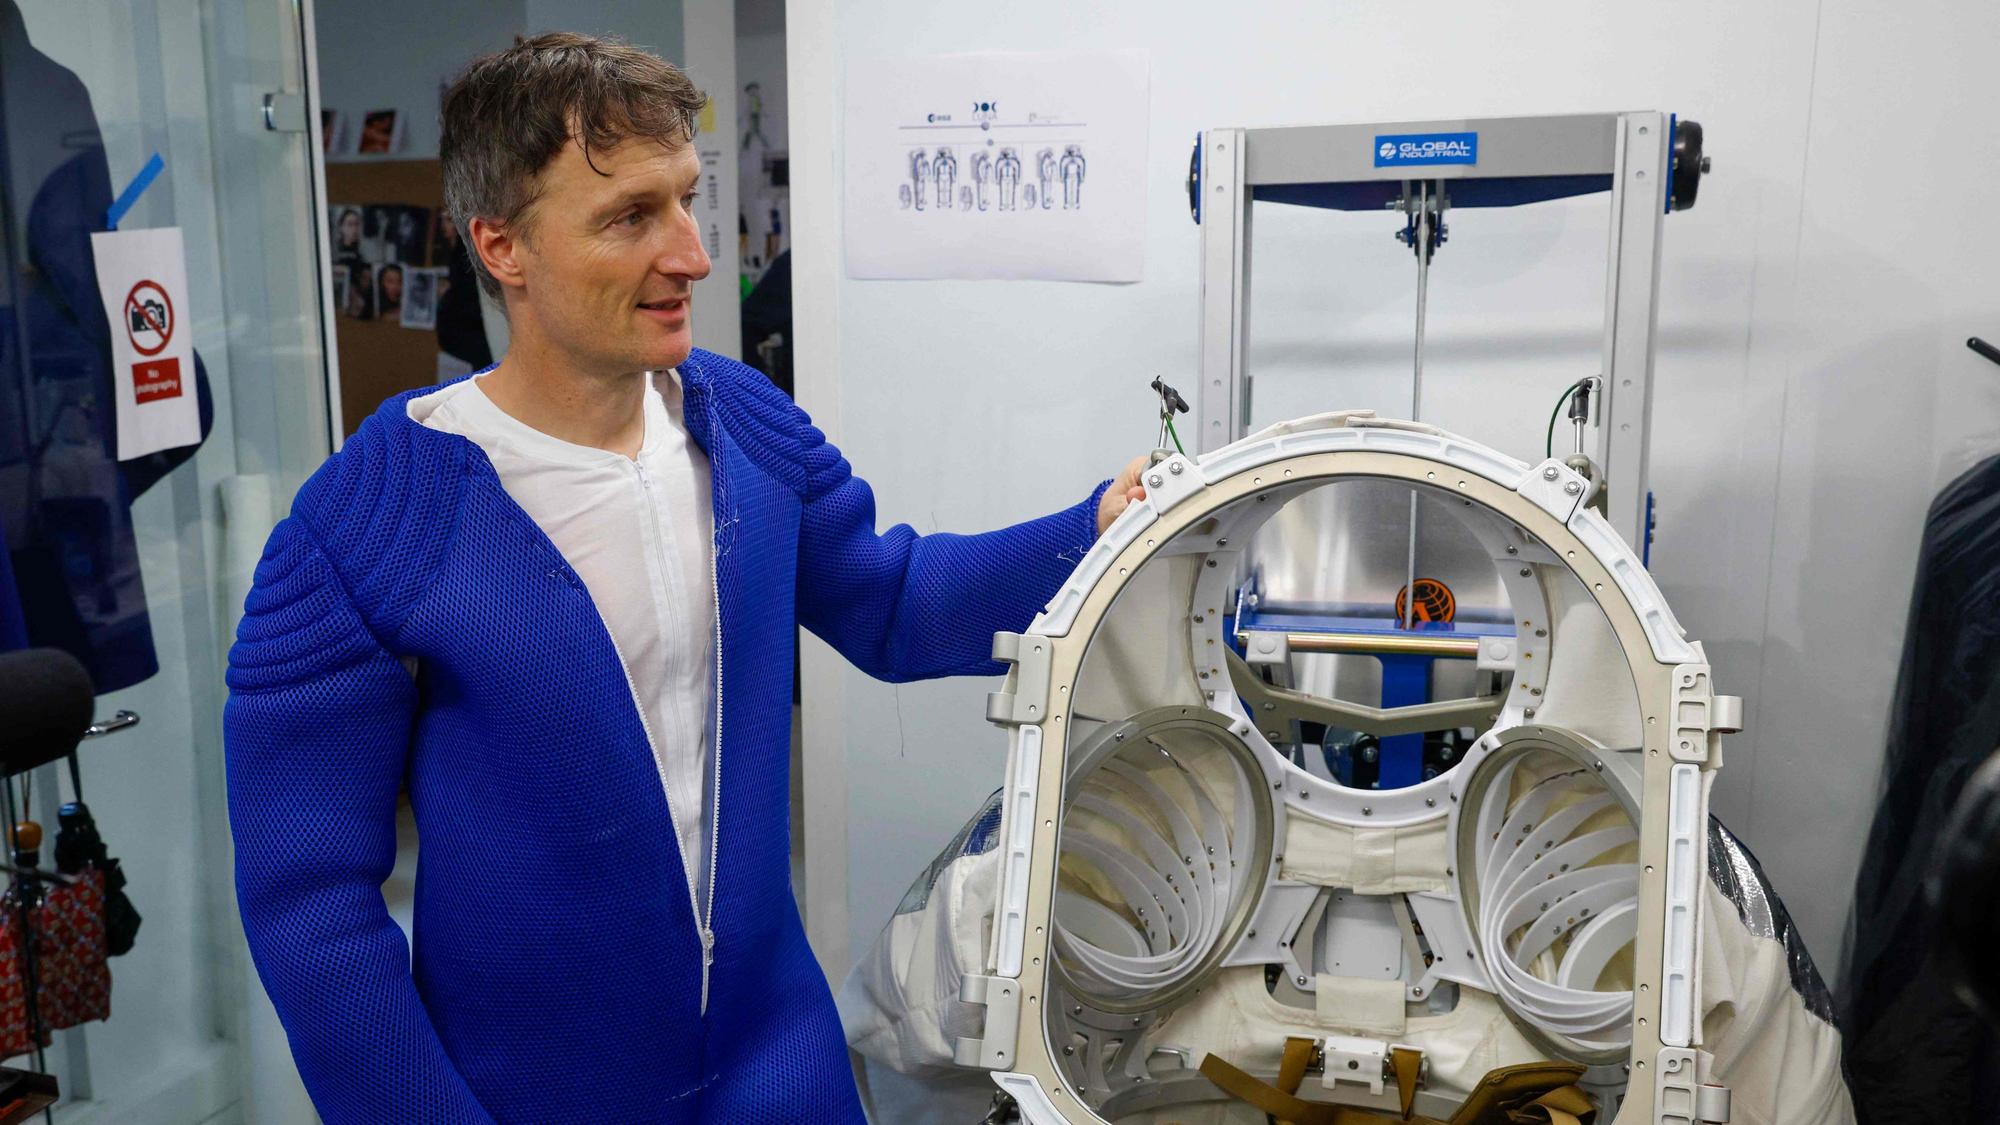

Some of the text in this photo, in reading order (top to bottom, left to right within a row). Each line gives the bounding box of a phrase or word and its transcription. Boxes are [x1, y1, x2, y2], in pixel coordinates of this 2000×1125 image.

[1399, 141, 1471, 152] GLOBAL
[1399, 150, 1471, 159] INDUSTRIAL
[147, 369, 160, 379] No
